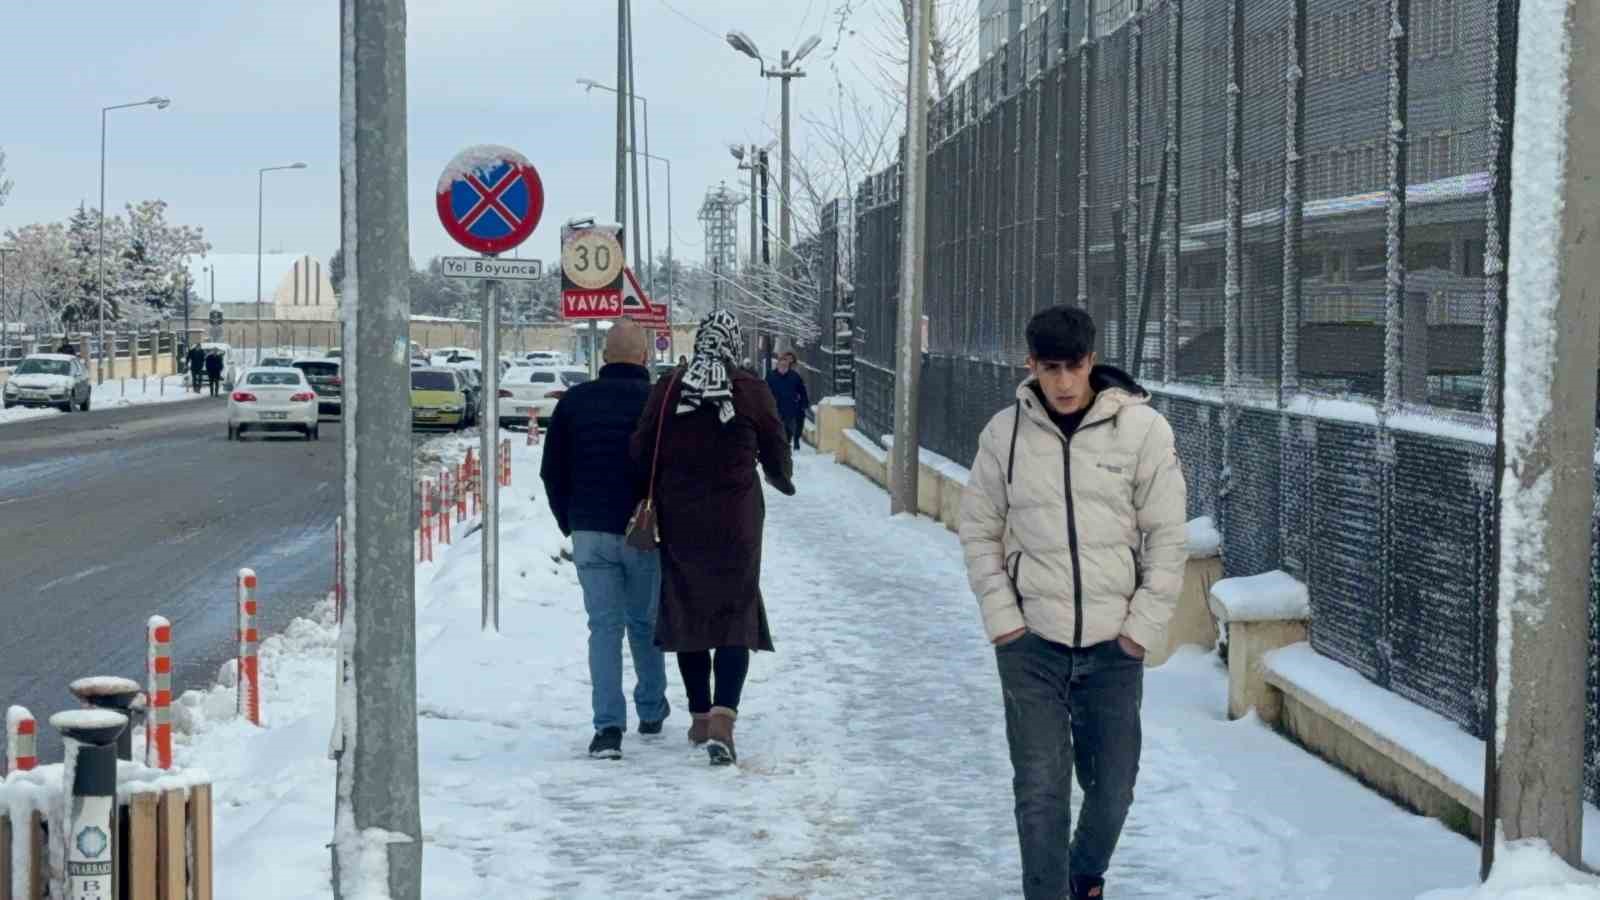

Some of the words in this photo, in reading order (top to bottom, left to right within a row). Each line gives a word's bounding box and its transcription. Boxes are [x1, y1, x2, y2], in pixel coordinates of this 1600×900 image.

[574, 245, 610, 271] 30
[447, 261, 467, 272] Yol
[474, 261, 537, 275] Boyunca
[567, 294, 620, 312] YAVAŞ
